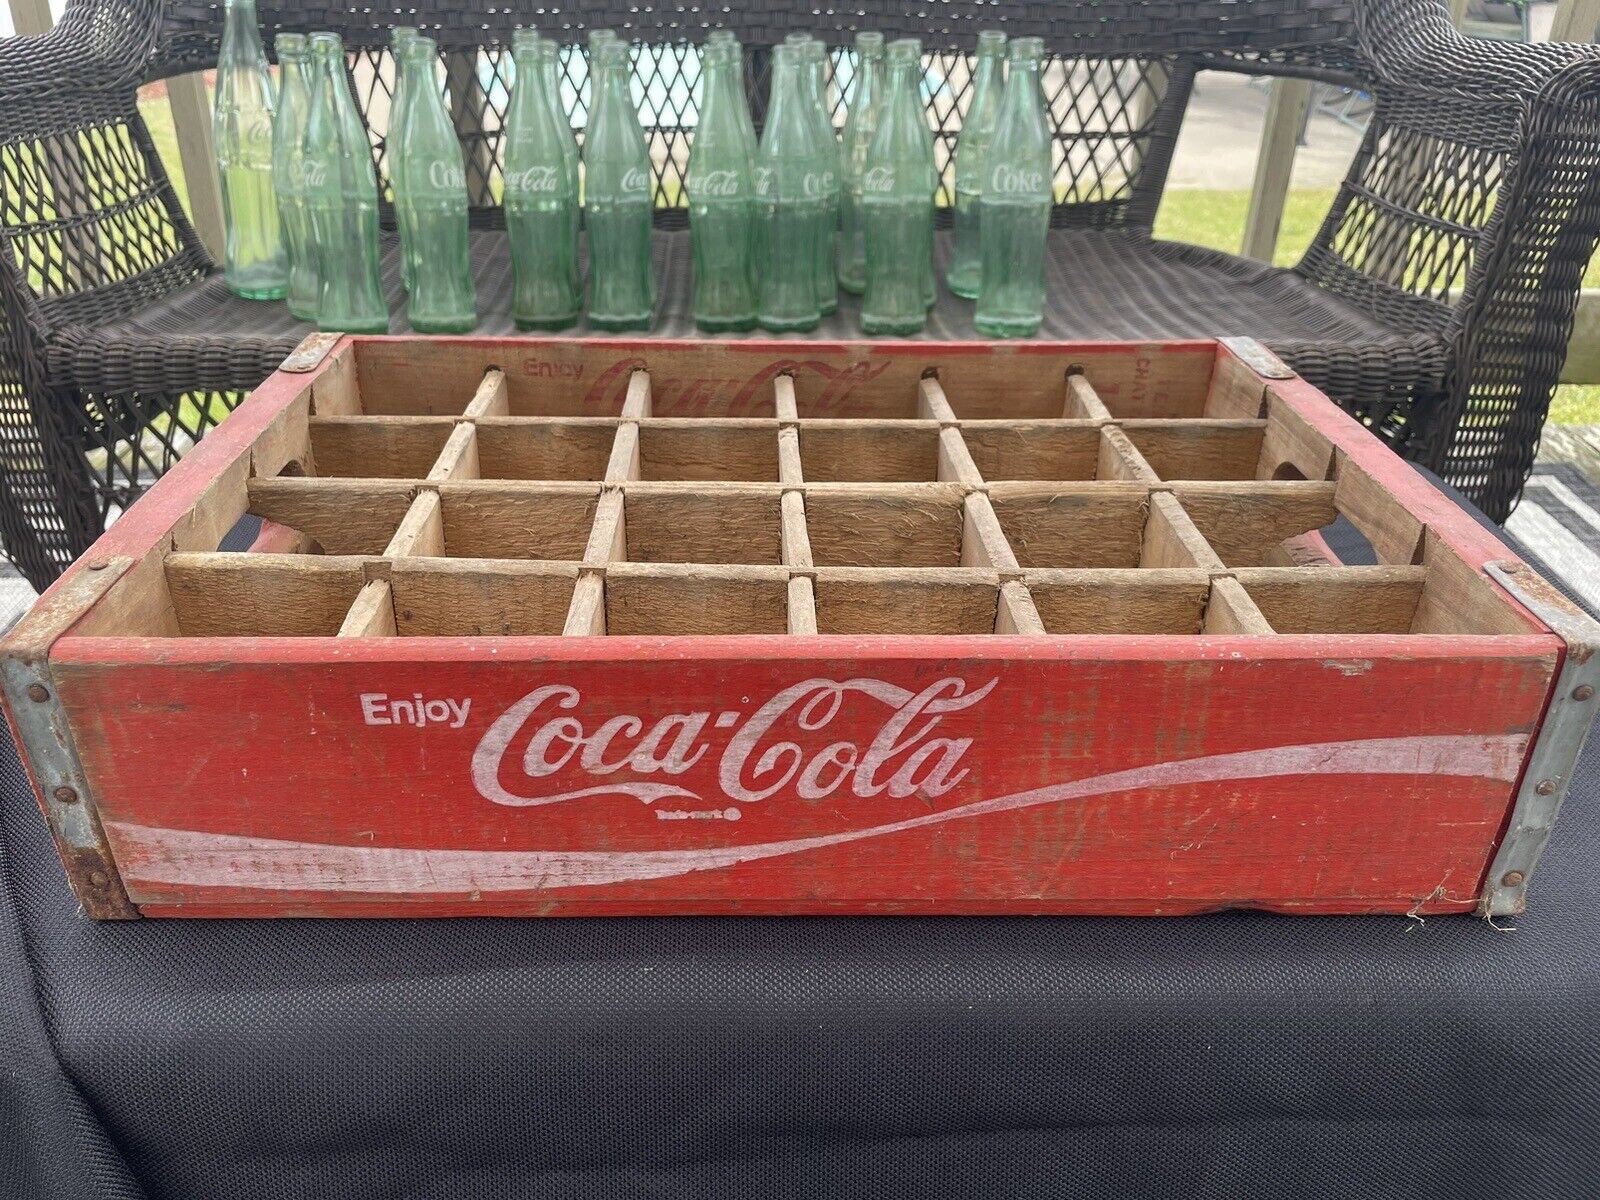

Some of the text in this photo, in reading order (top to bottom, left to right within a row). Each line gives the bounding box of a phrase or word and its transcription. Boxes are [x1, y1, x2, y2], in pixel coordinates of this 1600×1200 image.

[992, 163, 1042, 193] Coke
[360, 676, 999, 807] Enjoy Coca-Cola
